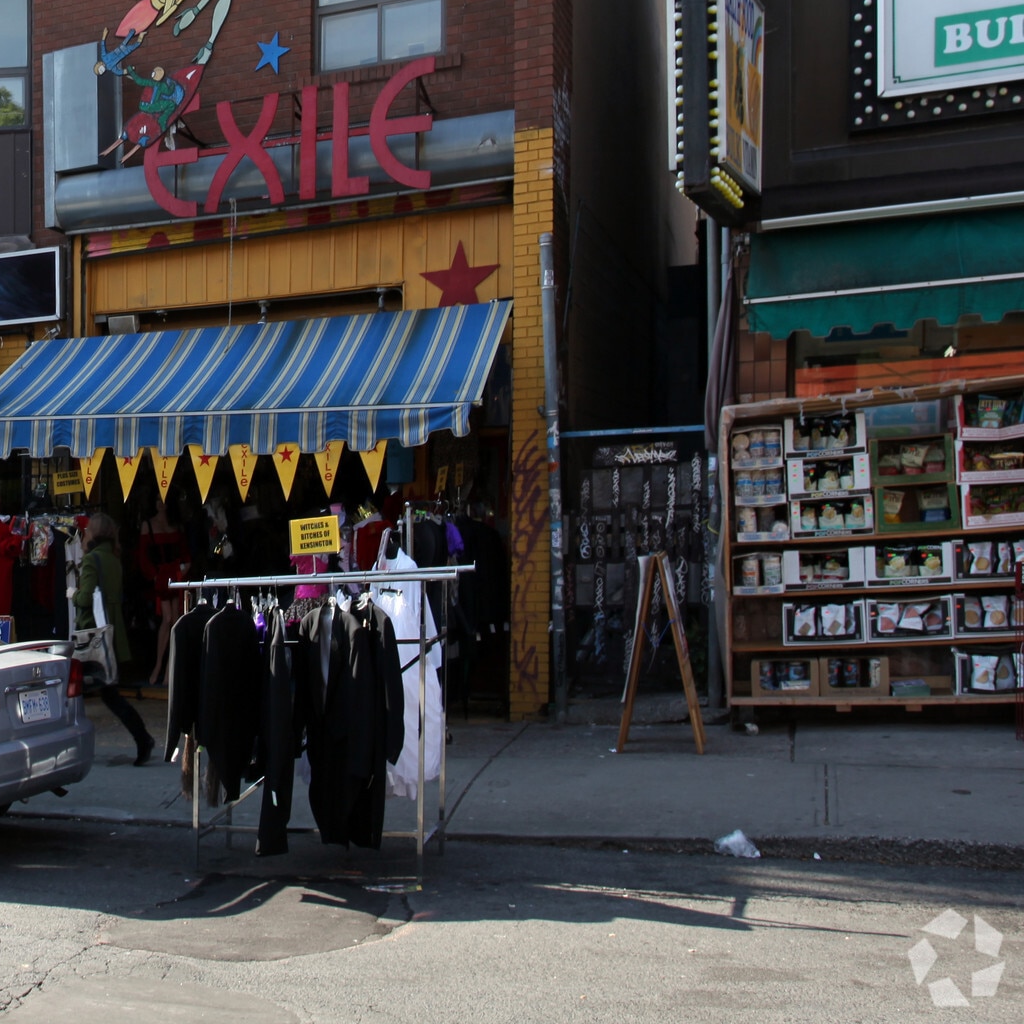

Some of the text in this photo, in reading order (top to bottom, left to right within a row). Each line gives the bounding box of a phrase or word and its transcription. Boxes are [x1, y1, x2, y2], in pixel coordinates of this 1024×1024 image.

[144, 56, 435, 218] EXILE
[300, 521, 324, 531] WITCHES
[300, 531, 323, 540] BITCHES
[300, 539, 333, 549] KENSINGTON
